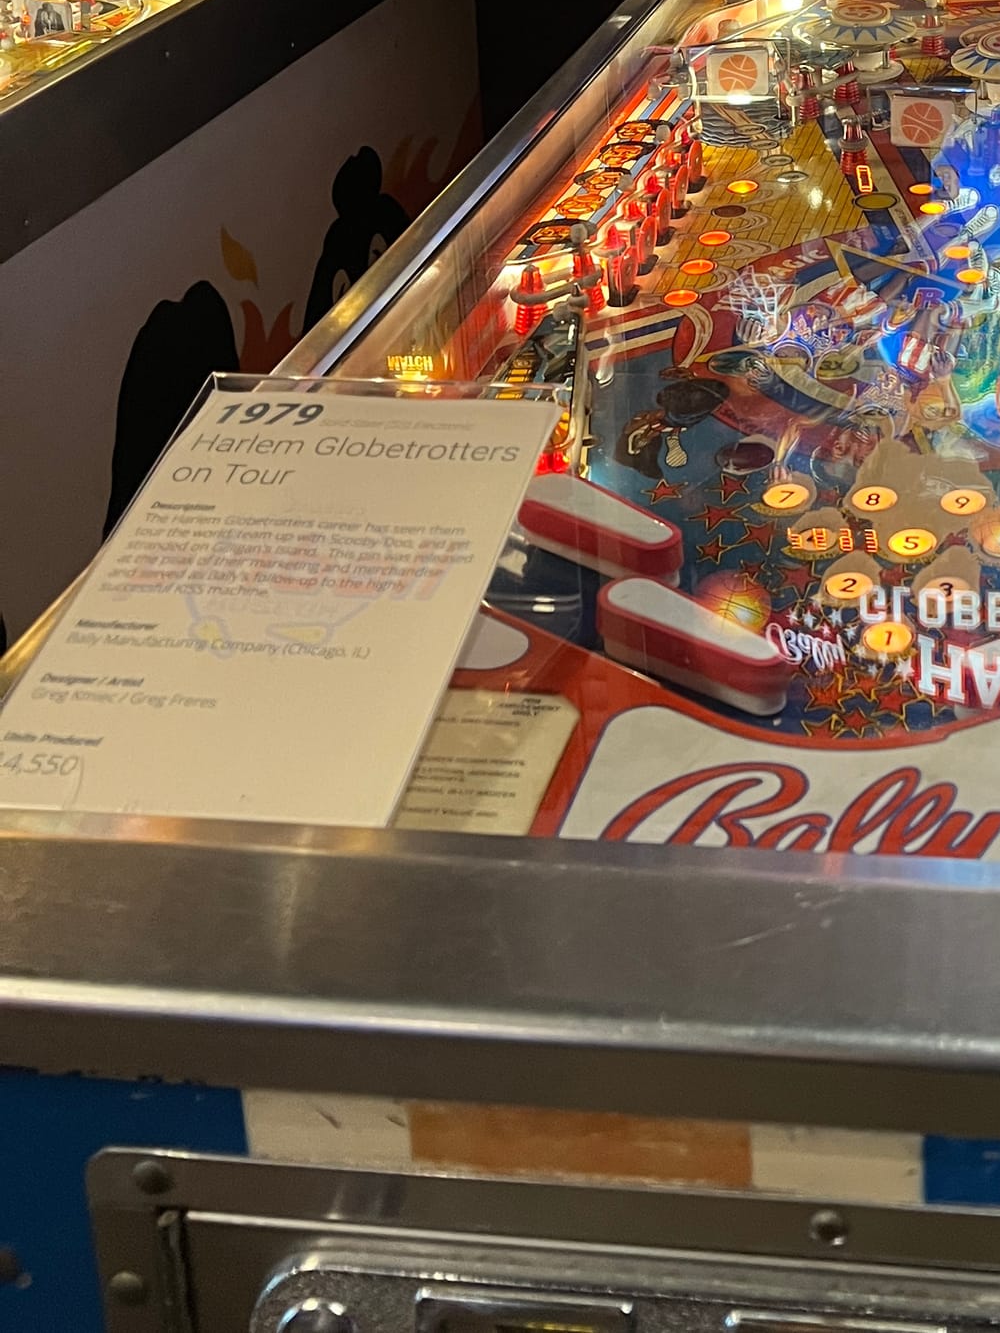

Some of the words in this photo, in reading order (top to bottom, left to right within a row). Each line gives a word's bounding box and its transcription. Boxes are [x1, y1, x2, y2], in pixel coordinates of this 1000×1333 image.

[216, 403, 325, 426] 1979
[191, 433, 305, 456] Harlem
[314, 436, 521, 463] Globetrotters
[172, 466, 213, 484] on
[224, 463, 296, 486] Tour
[781, 490, 795, 504] 7
[866, 493, 880, 506] 8
[955, 496, 970, 508] 9
[146, 513, 169, 524] The
[903, 536, 919, 550] 5
[840, 578, 857, 593] 2
[885, 631, 893, 646] 1
[209, 638, 280, 657] Company
